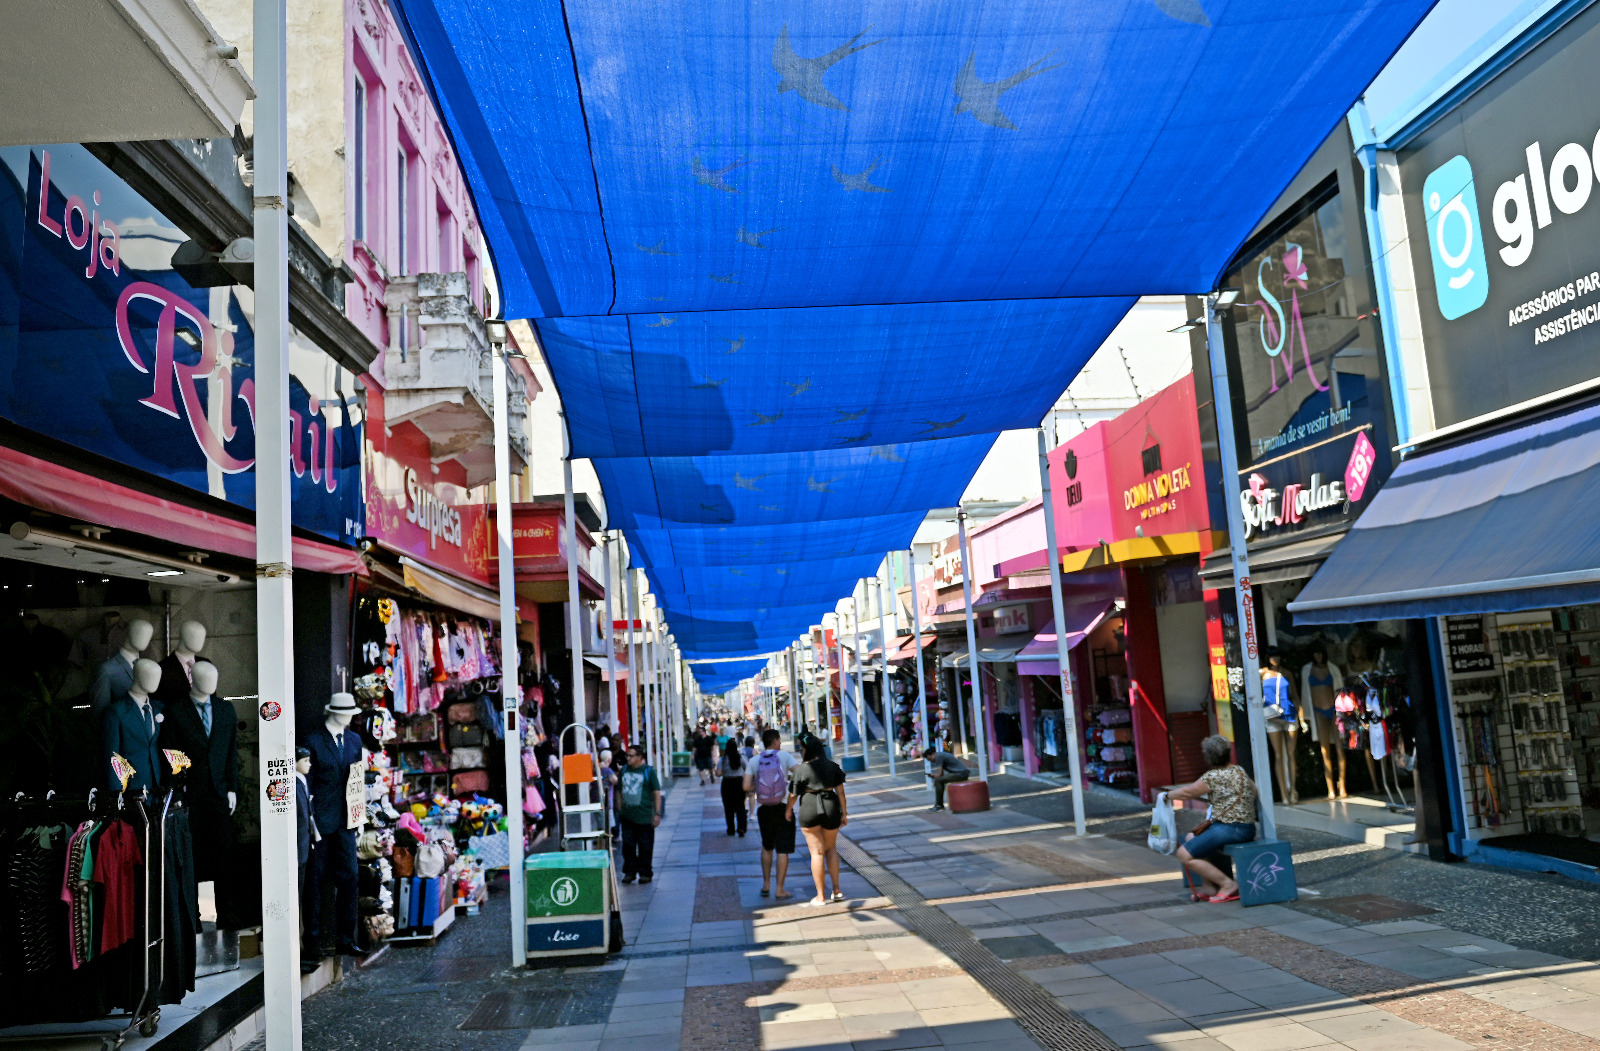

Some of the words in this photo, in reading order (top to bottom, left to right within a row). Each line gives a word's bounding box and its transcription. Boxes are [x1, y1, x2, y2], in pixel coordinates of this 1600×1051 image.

[38, 150, 120, 278] Loja
[1492, 128, 1600, 267] glo
[1508, 283, 1576, 327] ACESSÓRIOS
[1257, 438, 1264, 456] A
[1264, 429, 1287, 452] mania
[1287, 424, 1297, 443] de
[1297, 425, 1306, 439] se
[1306, 411, 1329, 435] vestir
[1329, 400, 1351, 427] bem!
[405, 467, 463, 550] Surpresa
[1123, 481, 1155, 511] DONNA
[1153, 466, 1191, 499] VIOLETA
[1240, 488, 1277, 539] Sofi
[1275, 472, 1345, 526] Modas
[1452, 646, 1458, 655] 2
